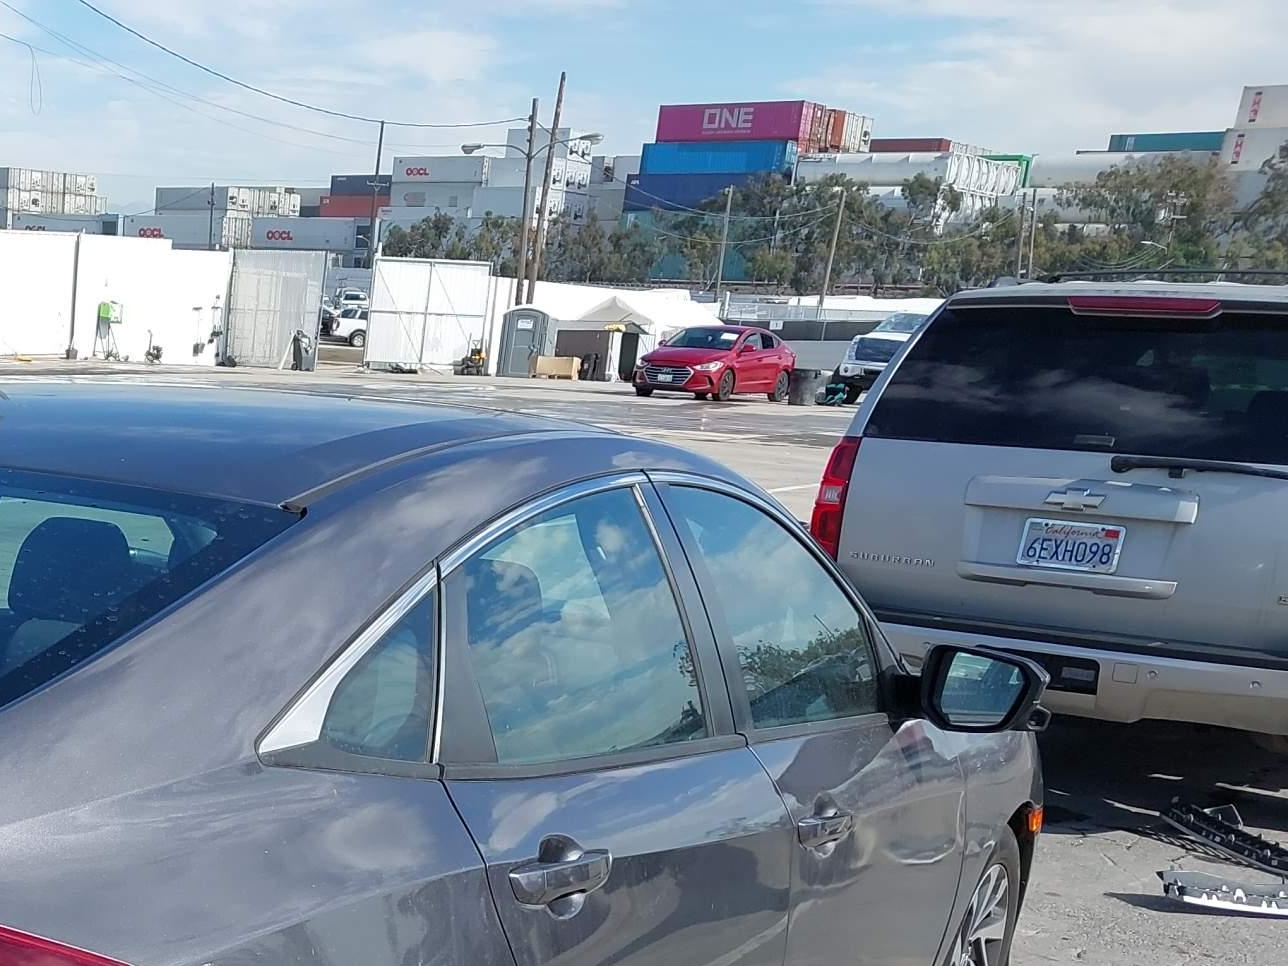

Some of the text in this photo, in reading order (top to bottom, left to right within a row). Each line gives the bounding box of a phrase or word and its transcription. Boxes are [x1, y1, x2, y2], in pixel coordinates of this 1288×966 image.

[702, 107, 754, 128] ONE
[405, 167, 430, 177] OOCL
[138, 227, 165, 239] OOCL
[265, 229, 294, 241] OOCL
[1045, 526, 1099, 539] California
[1026, 537, 1113, 565] 6EXH098
[849, 551, 935, 568] SUBURBAN
